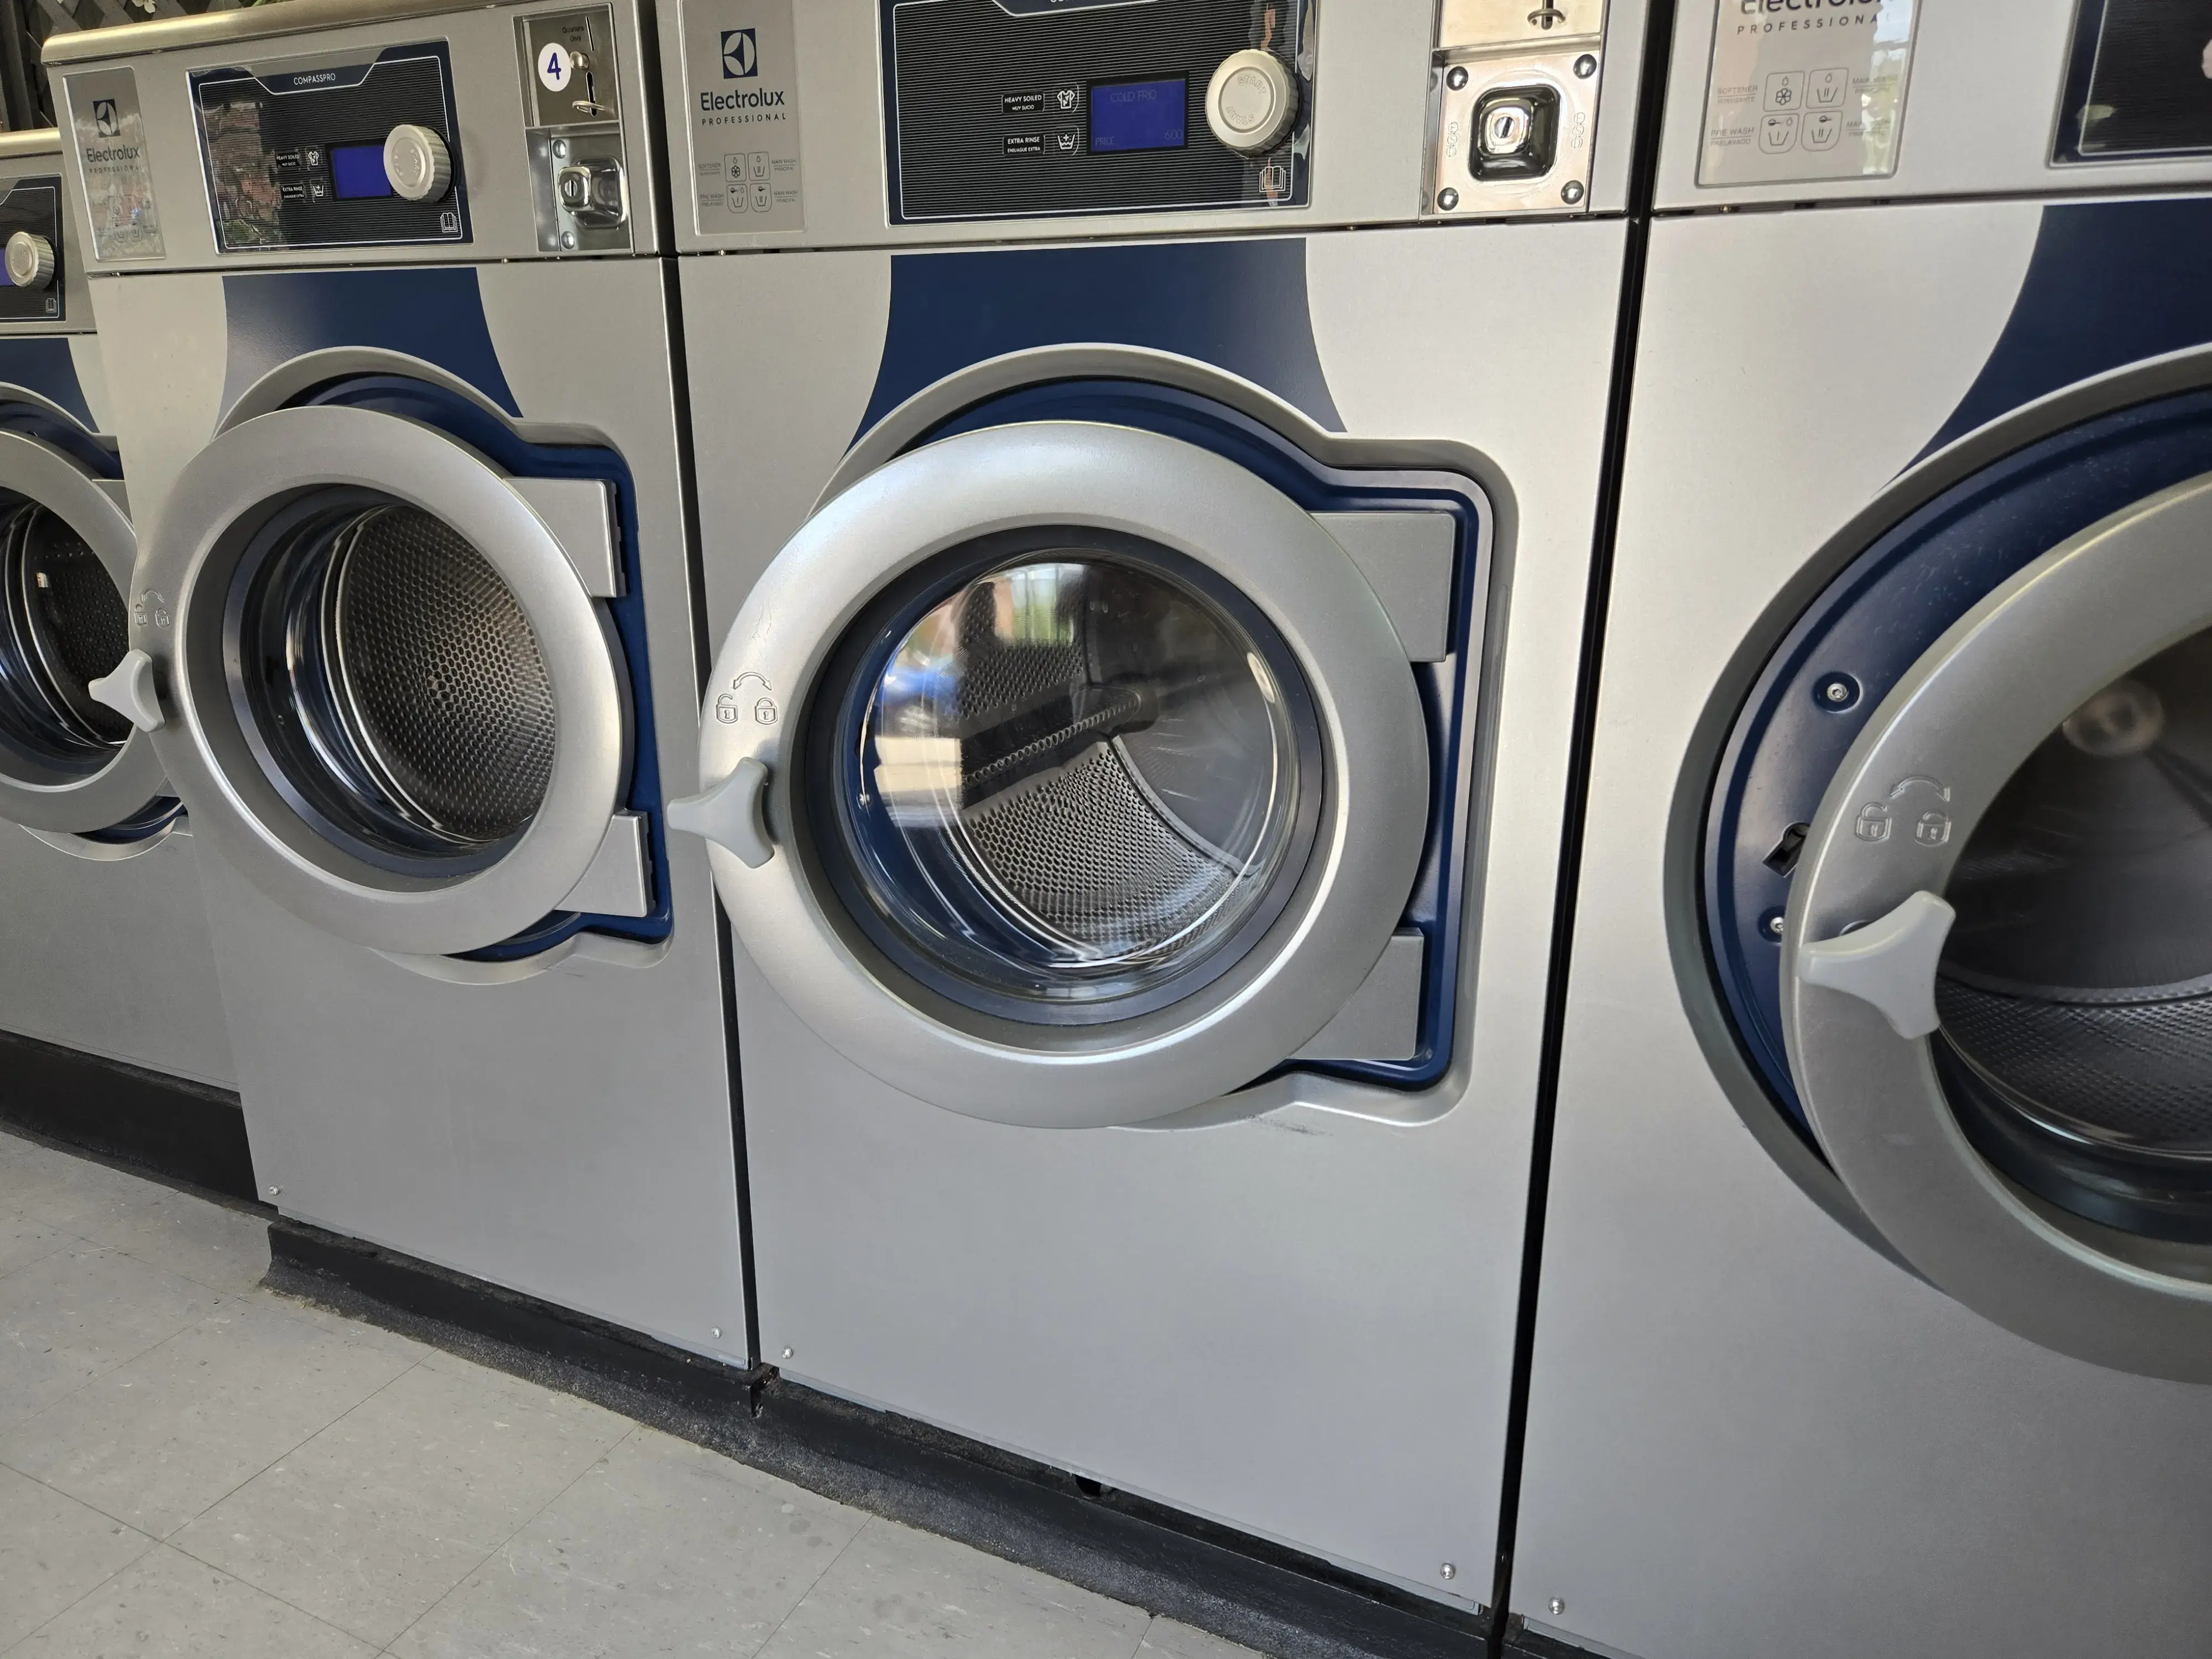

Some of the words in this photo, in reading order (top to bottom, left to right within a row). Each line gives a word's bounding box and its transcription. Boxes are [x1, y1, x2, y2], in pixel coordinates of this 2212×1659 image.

[547, 52, 562, 81] 4
[293, 73, 336, 85] COMPASSPRO
[1238, 75, 1266, 95] START
[1110, 91, 1135, 102] COLD
[1137, 90, 1157, 101] FRIO
[1717, 85, 1758, 96] SOFTENER
[700, 88, 785, 111] Electrolux
[702, 113, 786, 126] PROFESSIONAL
[1730, 127, 1754, 135] WASH
[86, 144, 140, 163] Electrolux
